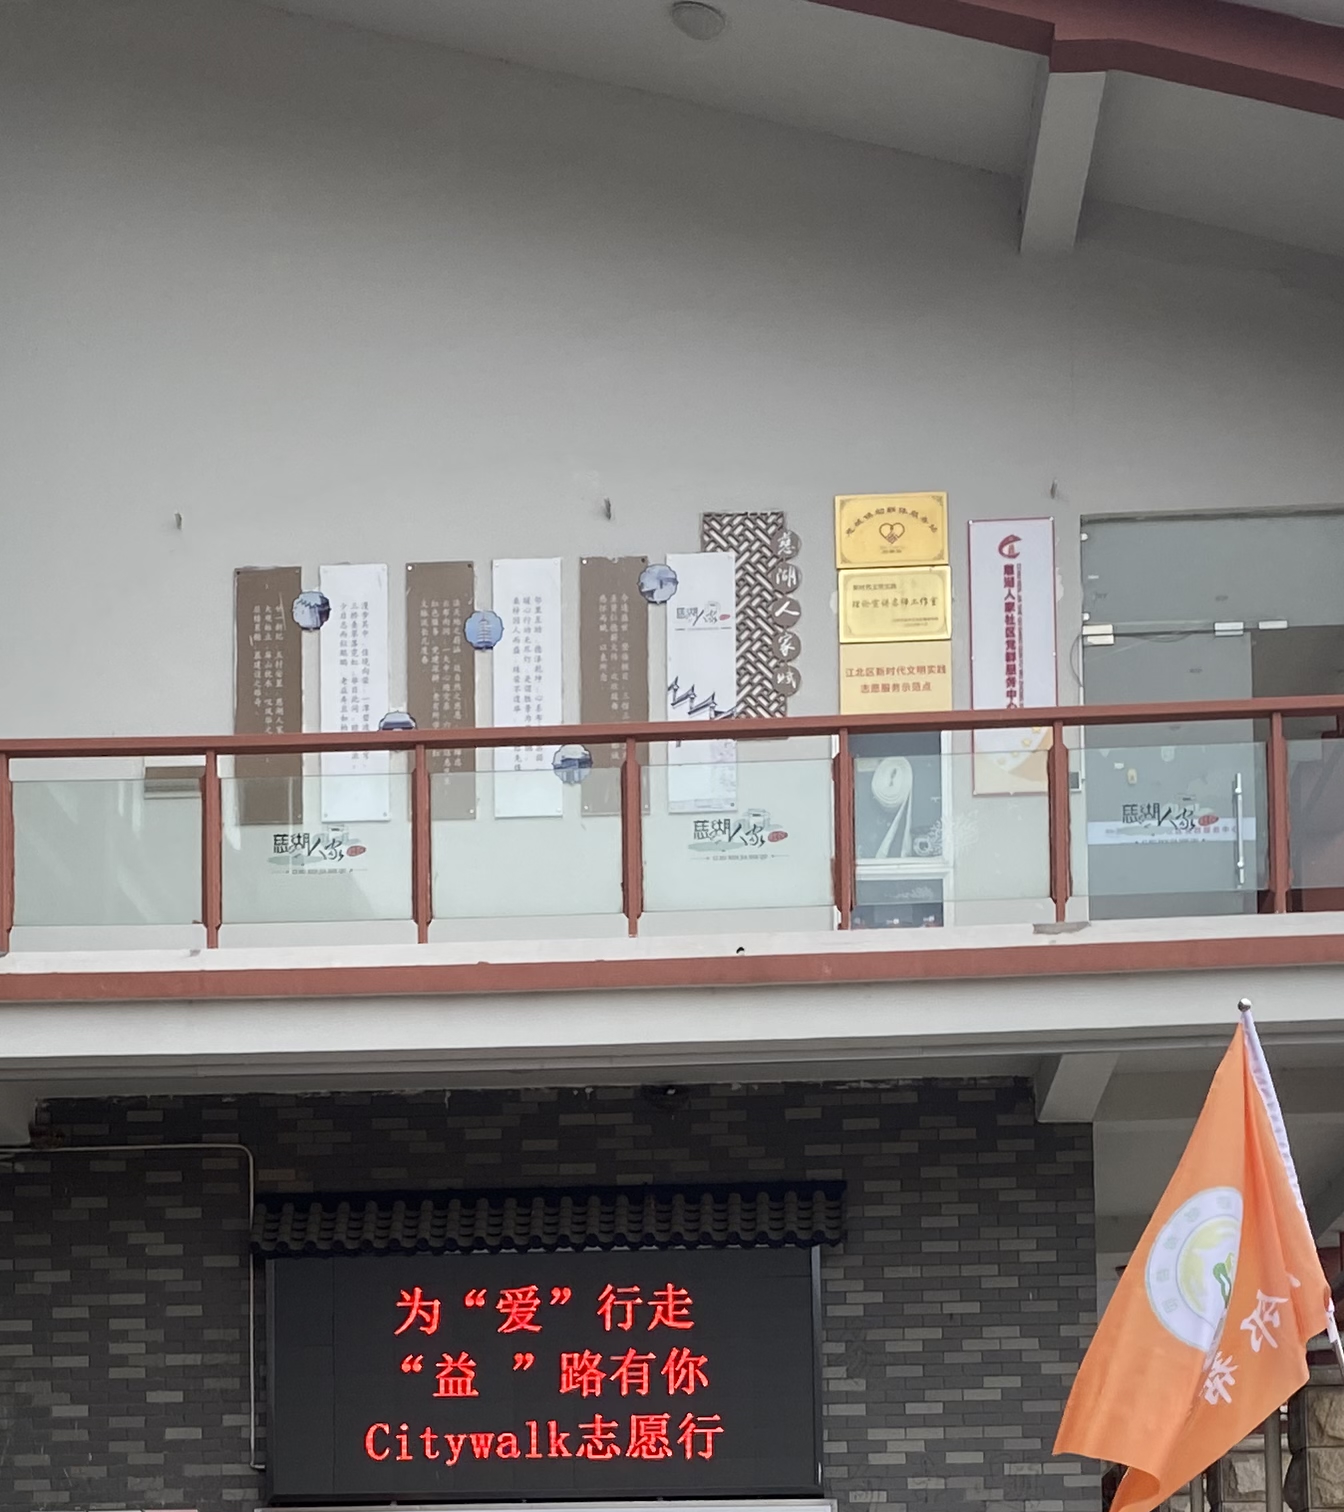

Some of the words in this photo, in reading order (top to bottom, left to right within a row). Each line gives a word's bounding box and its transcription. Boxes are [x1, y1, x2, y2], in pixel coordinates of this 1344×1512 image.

[845, 665, 946, 677] 江北区新时代文明实践
[860, 683, 932, 693] 志愿服务示范点
[394, 1282, 696, 1336] 为“爱”行走
[364, 1412, 725, 1466] Citywalk志愿行
